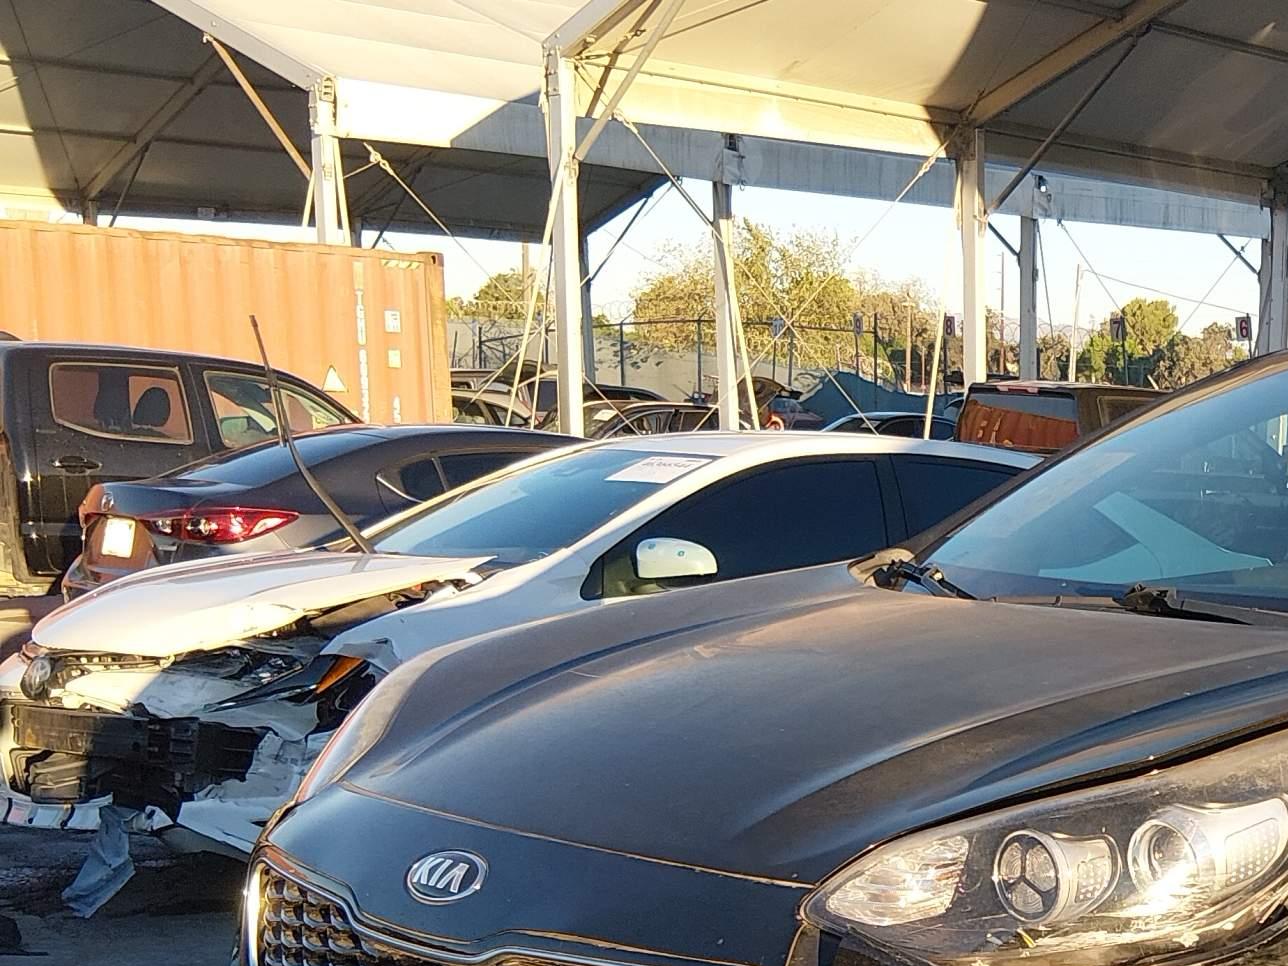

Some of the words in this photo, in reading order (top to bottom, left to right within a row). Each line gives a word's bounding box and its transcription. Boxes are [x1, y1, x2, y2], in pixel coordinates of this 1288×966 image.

[945, 318, 953, 336] 8
[1112, 320, 1121, 339] 7
[1239, 319, 1249, 338] 6
[412, 856, 470, 894] KIA
